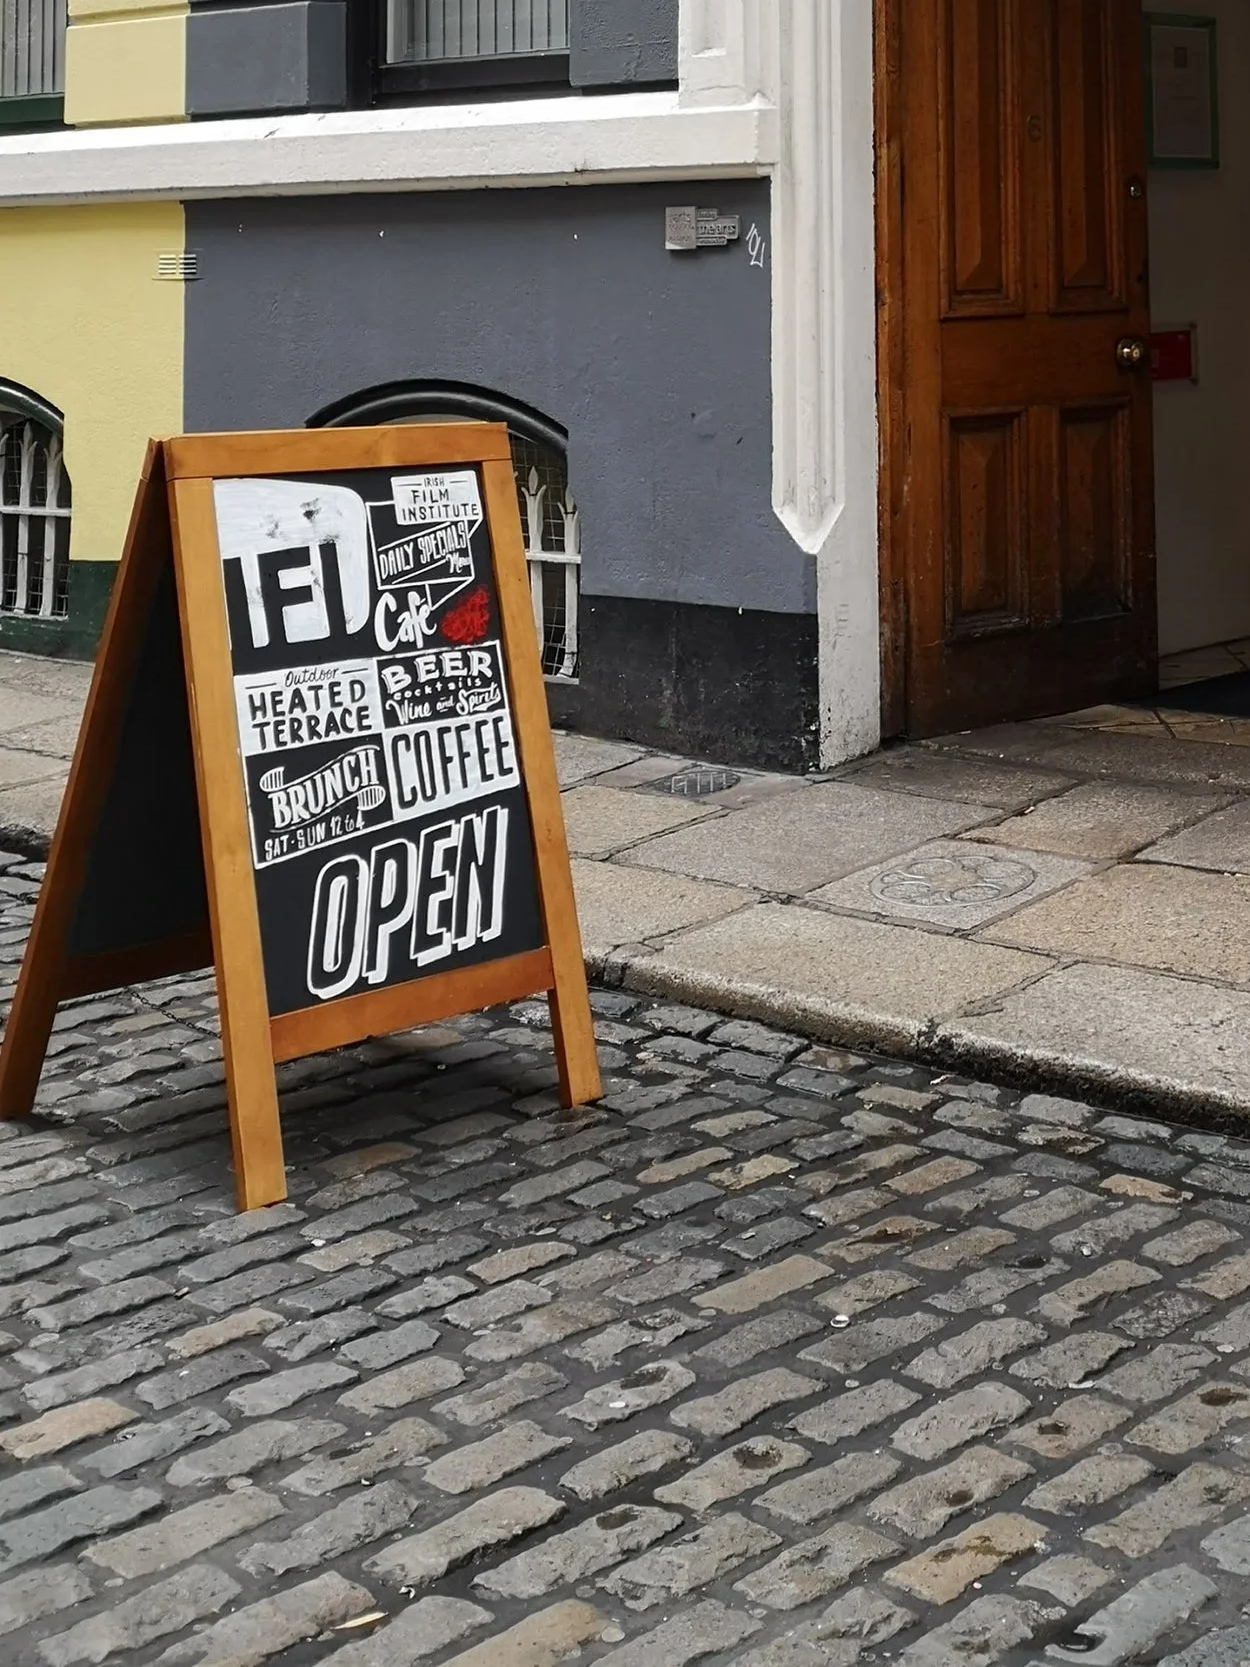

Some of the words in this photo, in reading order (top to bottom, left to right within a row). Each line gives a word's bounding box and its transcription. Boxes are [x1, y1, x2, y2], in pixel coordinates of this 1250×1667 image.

[411, 488, 450, 505] FILM
[424, 477, 445, 486] IRISH
[402, 503, 479, 521] INSTITUTE
[379, 542, 415, 580] DAILY
[417, 521, 468, 564] SPECIALS
[374, 590, 437, 652] Café
[284, 667, 340, 688] Outdoor
[382, 650, 494, 694] BEER
[393, 678, 482, 701] cocktails
[248, 679, 366, 722] HEATED
[385, 698, 433, 726] Wine
[436, 696, 455, 712] and
[455, 683, 502, 715] Spirits
[251, 706, 372, 750] TERRACE
[391, 716, 514, 811] COFFEE
[268, 749, 380, 830] BRUNCH
[330, 816, 343, 838] 12
[344, 816, 355, 833] to
[355, 810, 366, 831] 4
[306, 805, 508, 1000] OPEN
